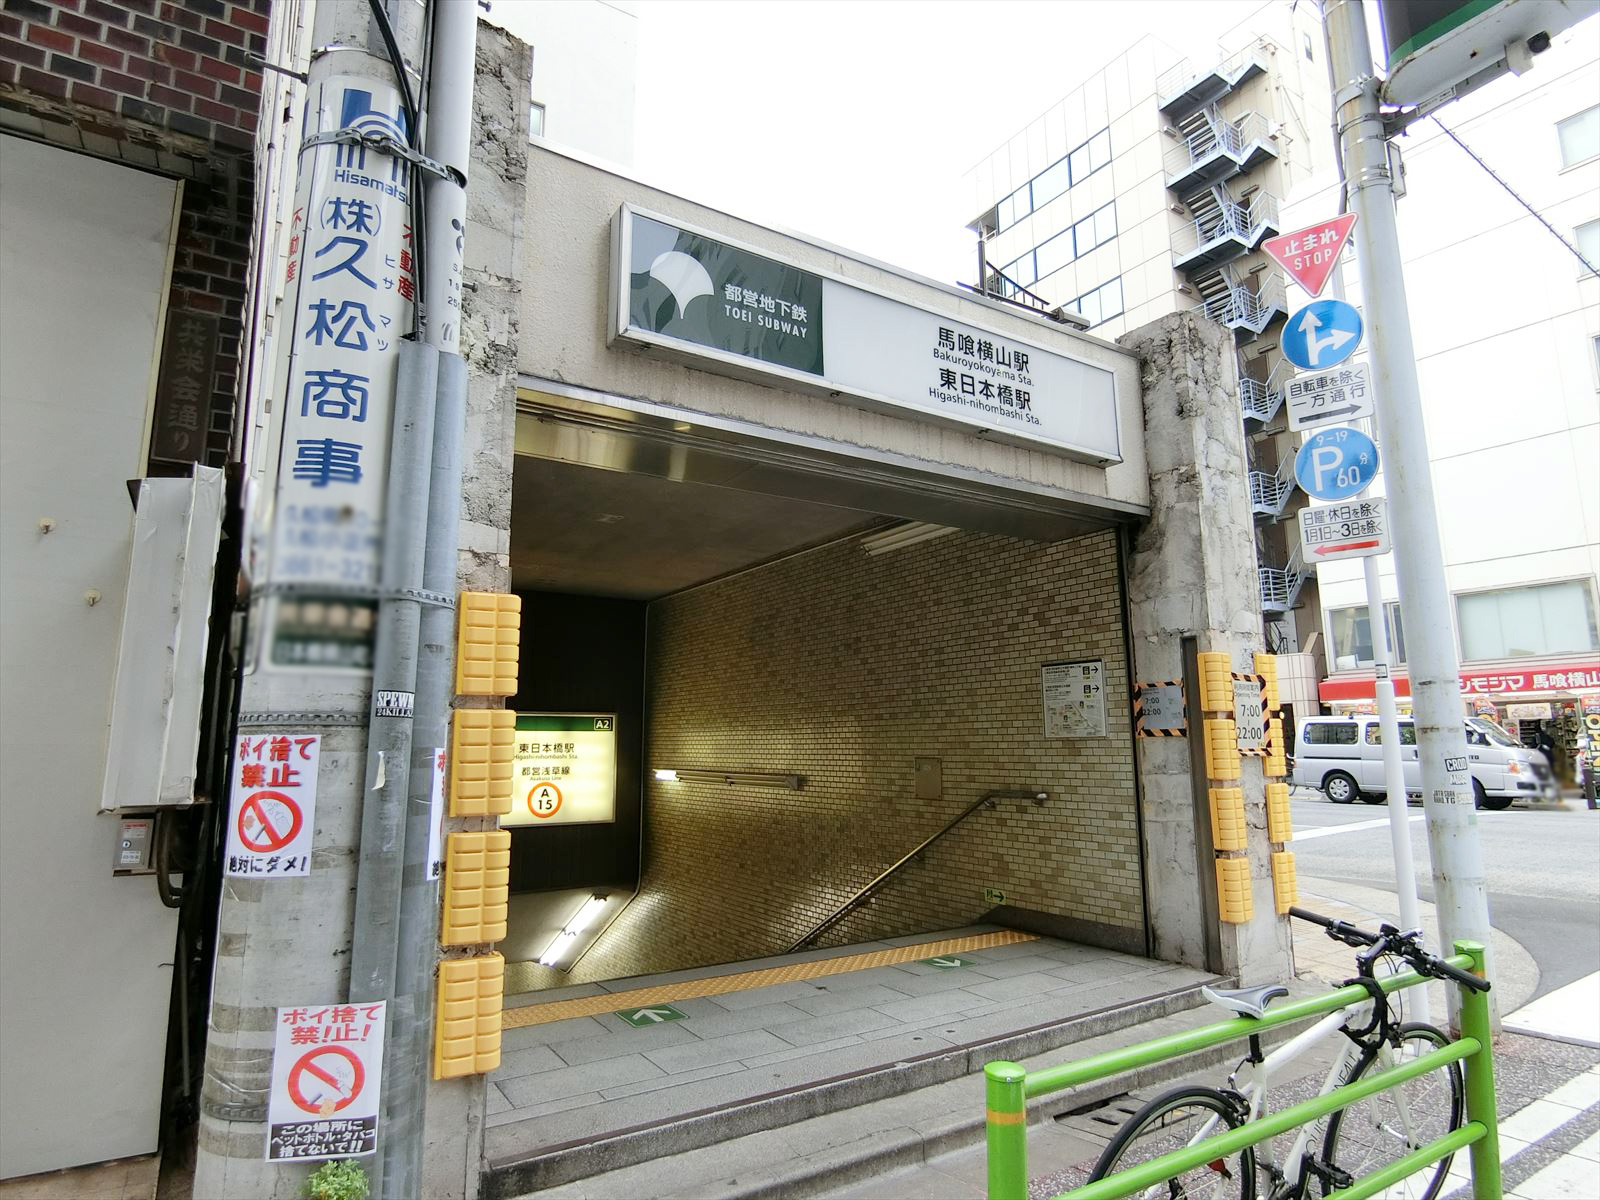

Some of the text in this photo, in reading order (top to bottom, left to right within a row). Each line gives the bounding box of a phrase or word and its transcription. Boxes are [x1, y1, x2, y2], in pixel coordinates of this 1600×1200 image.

[1283, 228, 1340, 258] 止まれ
[1294, 248, 1333, 271] STOP
[724, 283, 808, 324] 都営地下鉄
[724, 304, 808, 339] TOEI SUBWAY
[938, 326, 1030, 374] 馬喰横山駅
[933, 348, 1035, 387] Bakuroyokoyama Sta.
[167, 317, 208, 453] 共栄会通り
[939, 367, 1032, 412] 東日本橋駅
[1289, 369, 1365, 397] 自転車を除く
[928, 386, 1043, 426] Higashi-nihombashi Sta.
[1291, 384, 1366, 409] 一方通行
[1311, 446, 1345, 492] P
[1336, 465, 1361, 488] 60
[1533, 671, 1600, 689] 馬喰横山
[1241, 704, 1261, 717] 7:00
[595, 720, 610, 729] A2
[1236, 727, 1262, 740] 22:00
[239, 735, 317, 762] ポイ捨て
[519, 742, 575, 754] 東日本橋駅
[241, 763, 302, 788] 禁止
[521, 766, 570, 776] 都営浅草線
[538, 800, 553, 810] 15
[540, 788, 550, 798] A
[282, 1004, 384, 1025] ポイ捨て
[281, 1119, 364, 1136] この場所に
